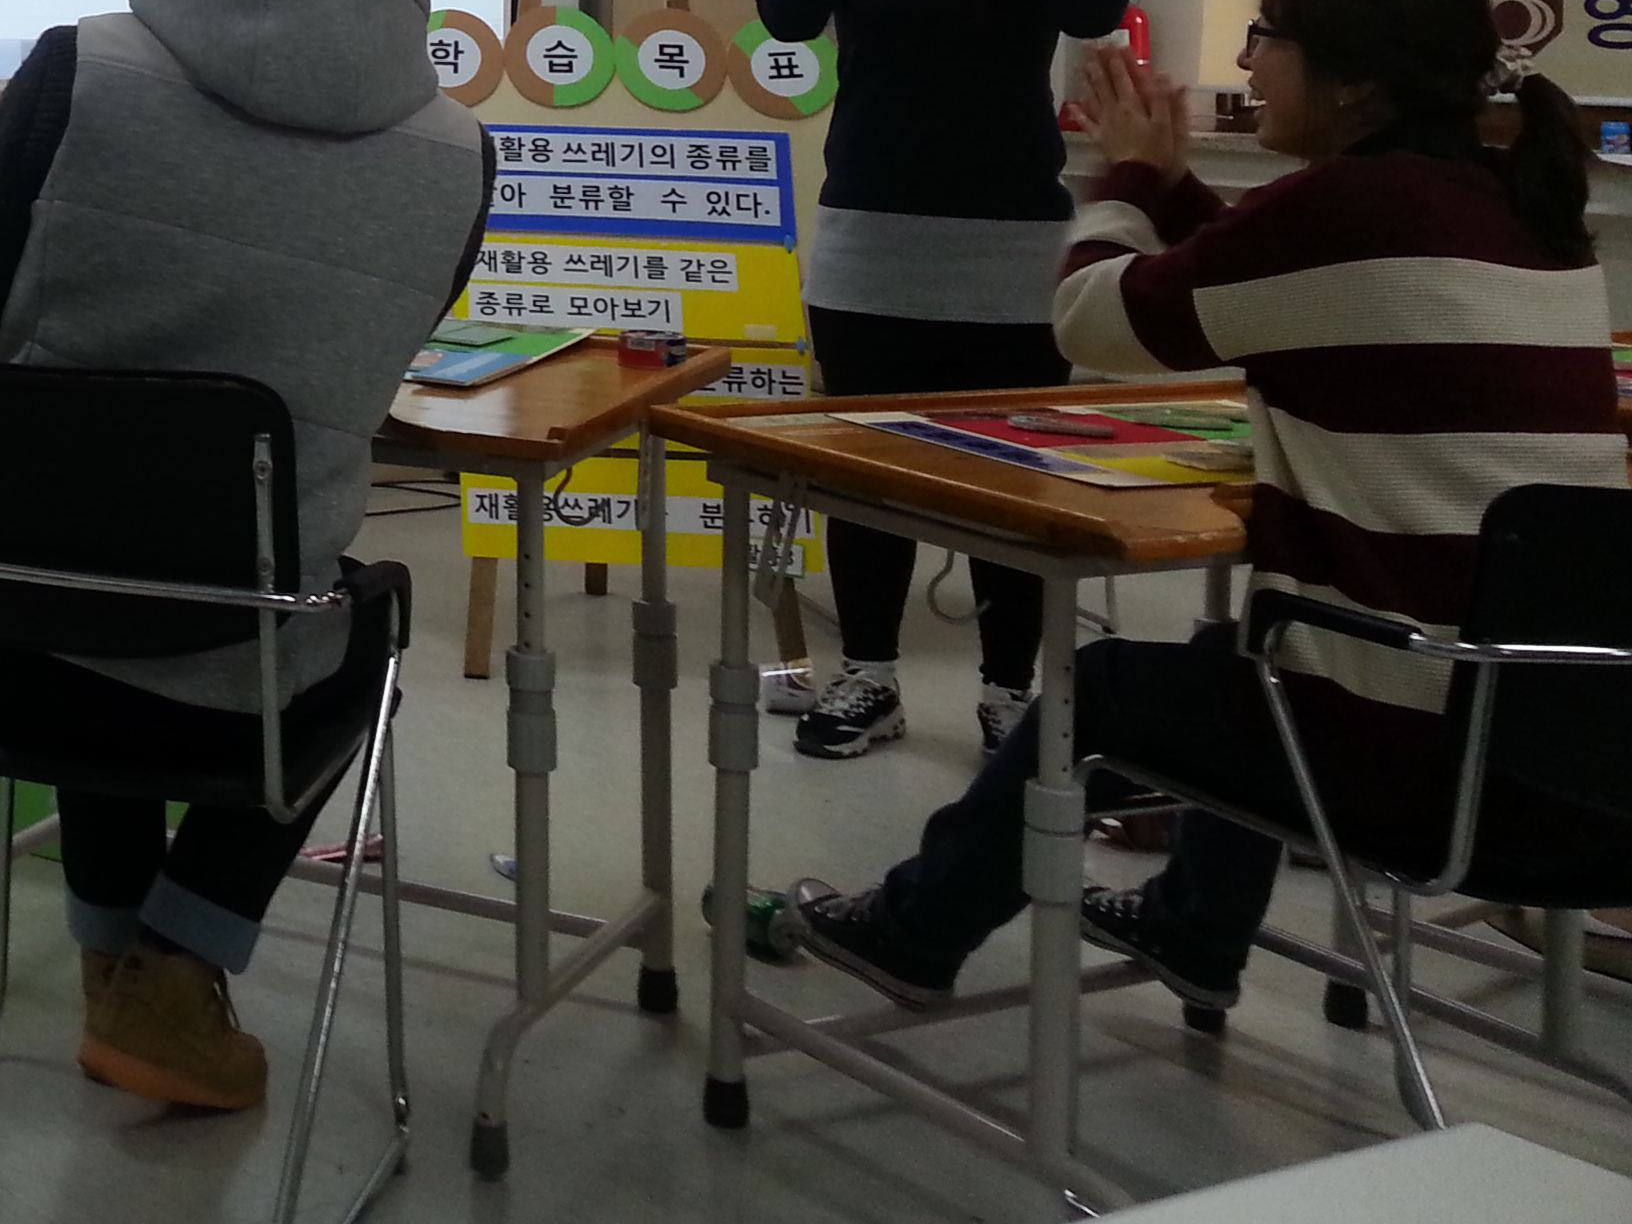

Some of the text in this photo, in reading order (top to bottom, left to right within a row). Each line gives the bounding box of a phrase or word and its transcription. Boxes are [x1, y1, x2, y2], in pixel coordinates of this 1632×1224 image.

[429, 39, 804, 80] 학 습 목 표
[490, 135, 773, 172] 활용 쓰레기의 종류를
[489, 181, 771, 218] 아 분류할 수 있다.
[476, 250, 734, 284] 재활용 쓰레기를 같은
[475, 291, 671, 323] 종류로 모아보기
[696, 366, 804, 395] 류하는
